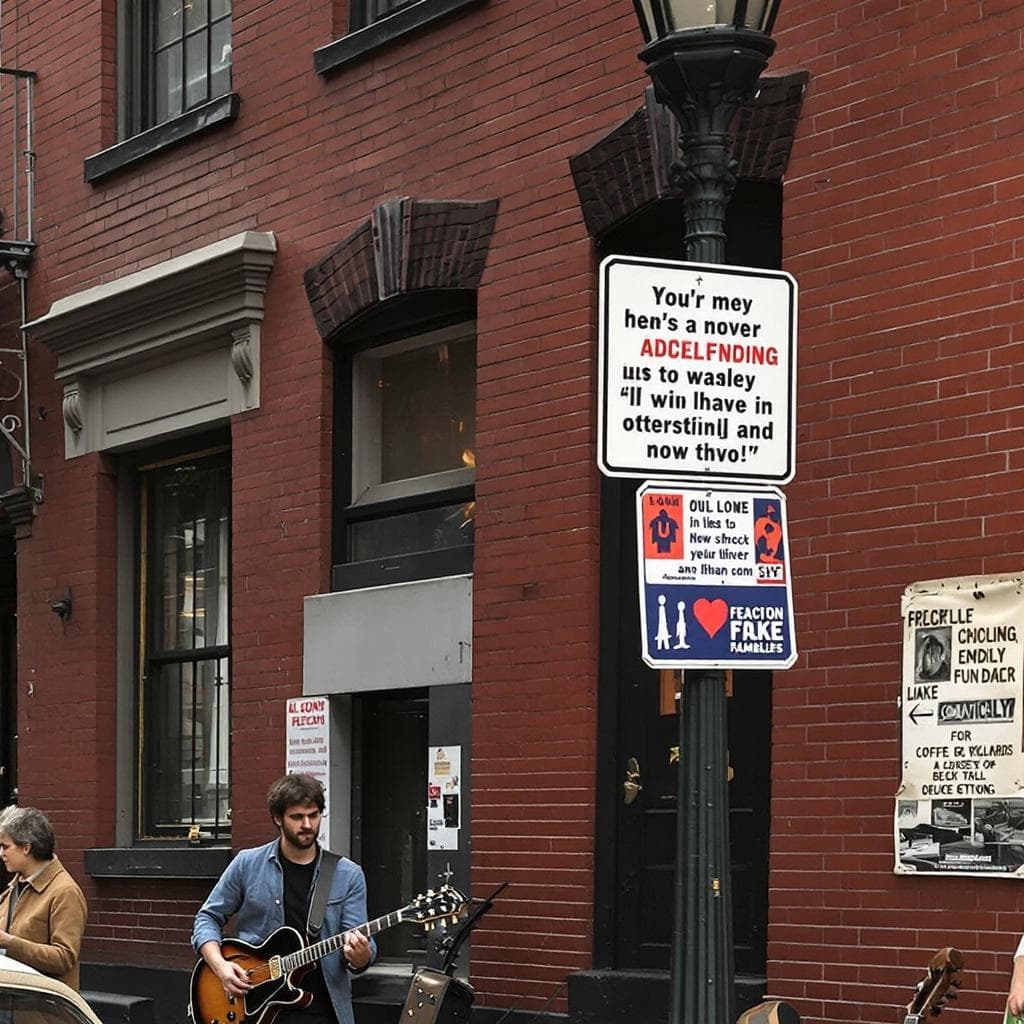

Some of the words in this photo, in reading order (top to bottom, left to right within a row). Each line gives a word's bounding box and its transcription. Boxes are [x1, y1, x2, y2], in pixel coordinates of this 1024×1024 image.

[652, 286, 705, 309] You'r
[712, 295, 753, 315] mey
[624, 308, 678, 331] hen's
[685, 319, 697, 334] a
[704, 319, 761, 338] nover
[658, 366, 679, 384] to
[755, 396, 773, 415] in
[736, 421, 774, 441] and
[647, 444, 689, 460] now
[950, 730, 972, 742] FOR
[915, 746, 949, 758] COFFE
